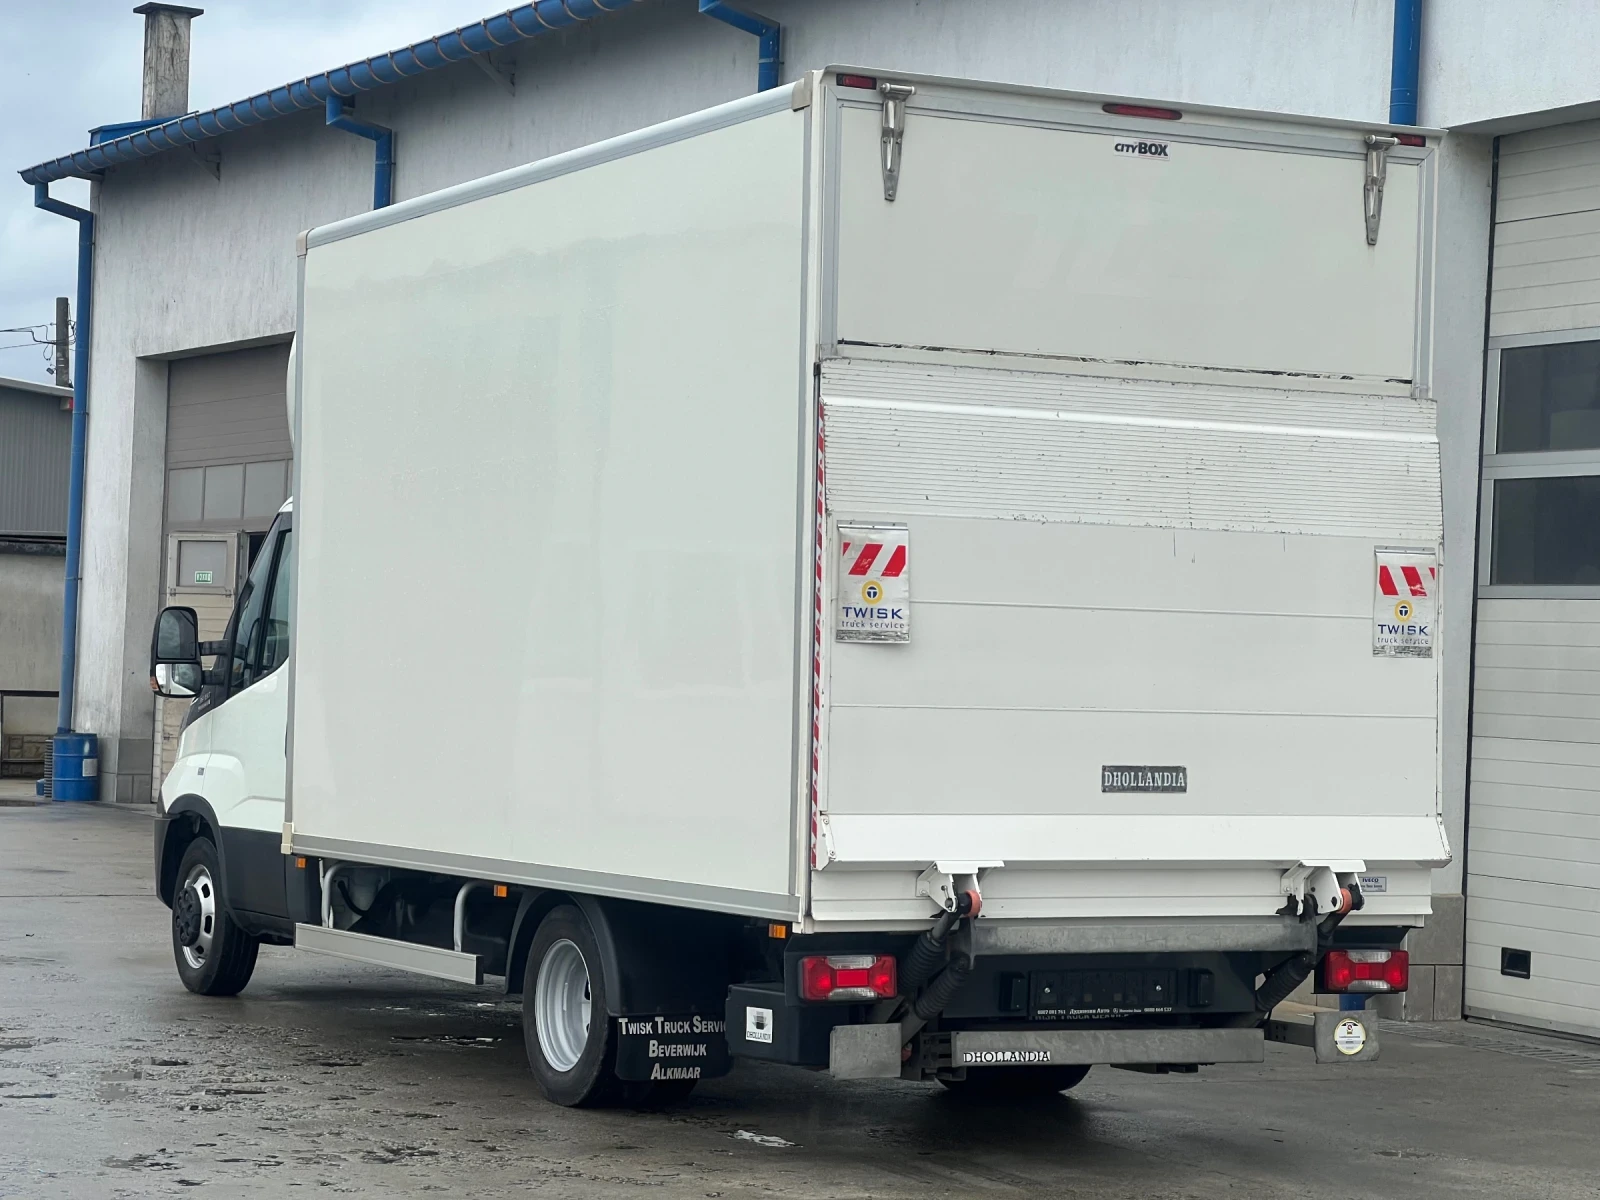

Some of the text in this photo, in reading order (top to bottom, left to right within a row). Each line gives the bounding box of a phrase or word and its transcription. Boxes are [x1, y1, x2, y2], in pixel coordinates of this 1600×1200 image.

[842, 606, 903, 620] TWISK
[841, 620, 905, 629] truck service
[1377, 624, 1428, 636] TWISK
[1377, 636, 1429, 646] truck service
[1104, 771, 1186, 787] DHOLLANDIA
[963, 1051, 1051, 1063] DHOLLANDIA
